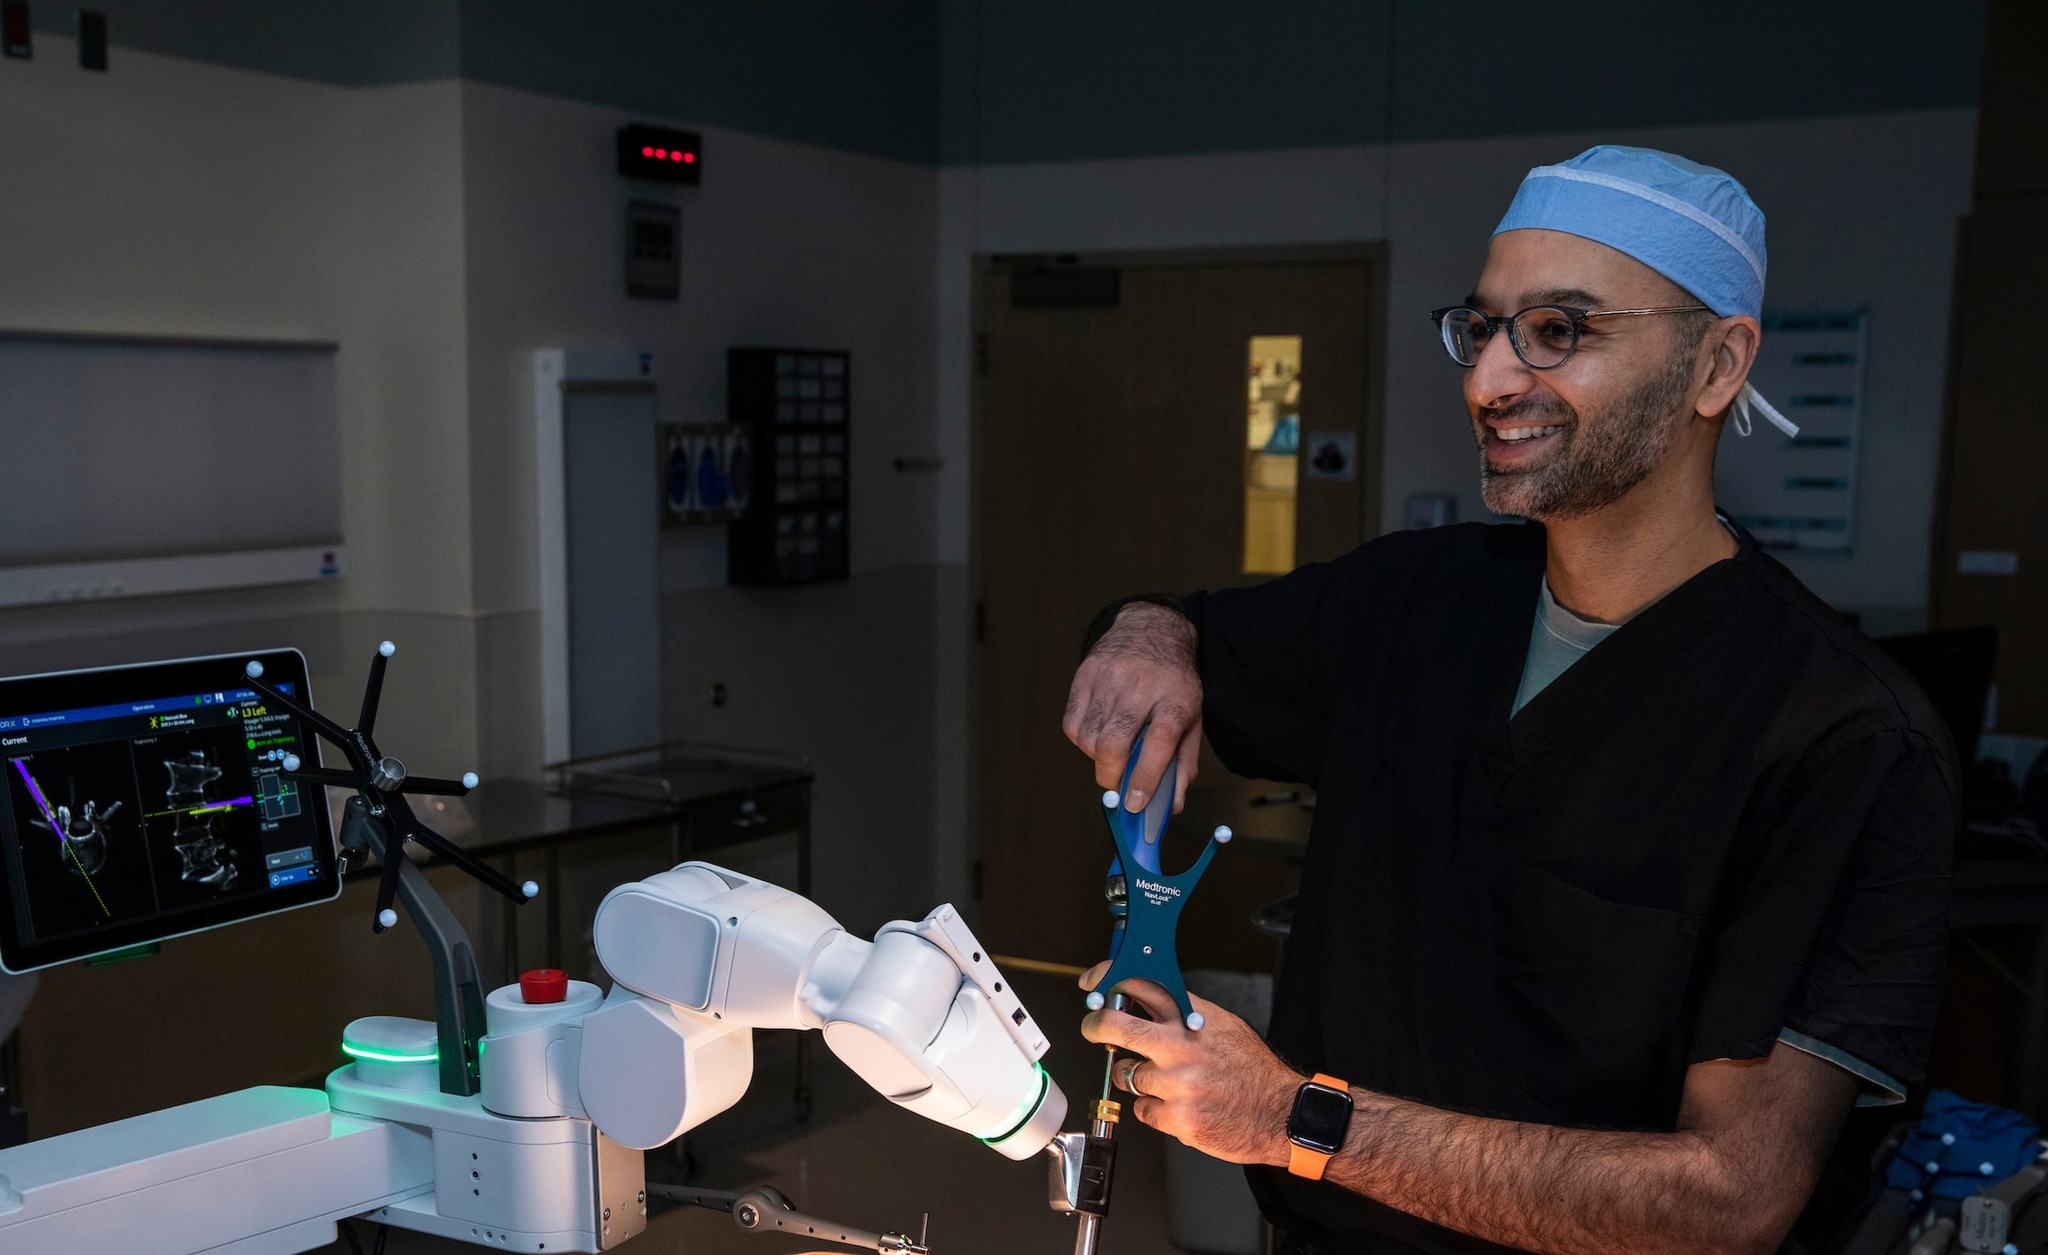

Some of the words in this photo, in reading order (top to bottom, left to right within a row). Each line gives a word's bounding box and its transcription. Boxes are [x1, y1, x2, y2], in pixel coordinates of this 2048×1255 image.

[241, 708, 252, 718] L3
[252, 705, 268, 716] Left
[2, 735, 28, 746] Current
[1135, 878, 1182, 897] Medtronic
